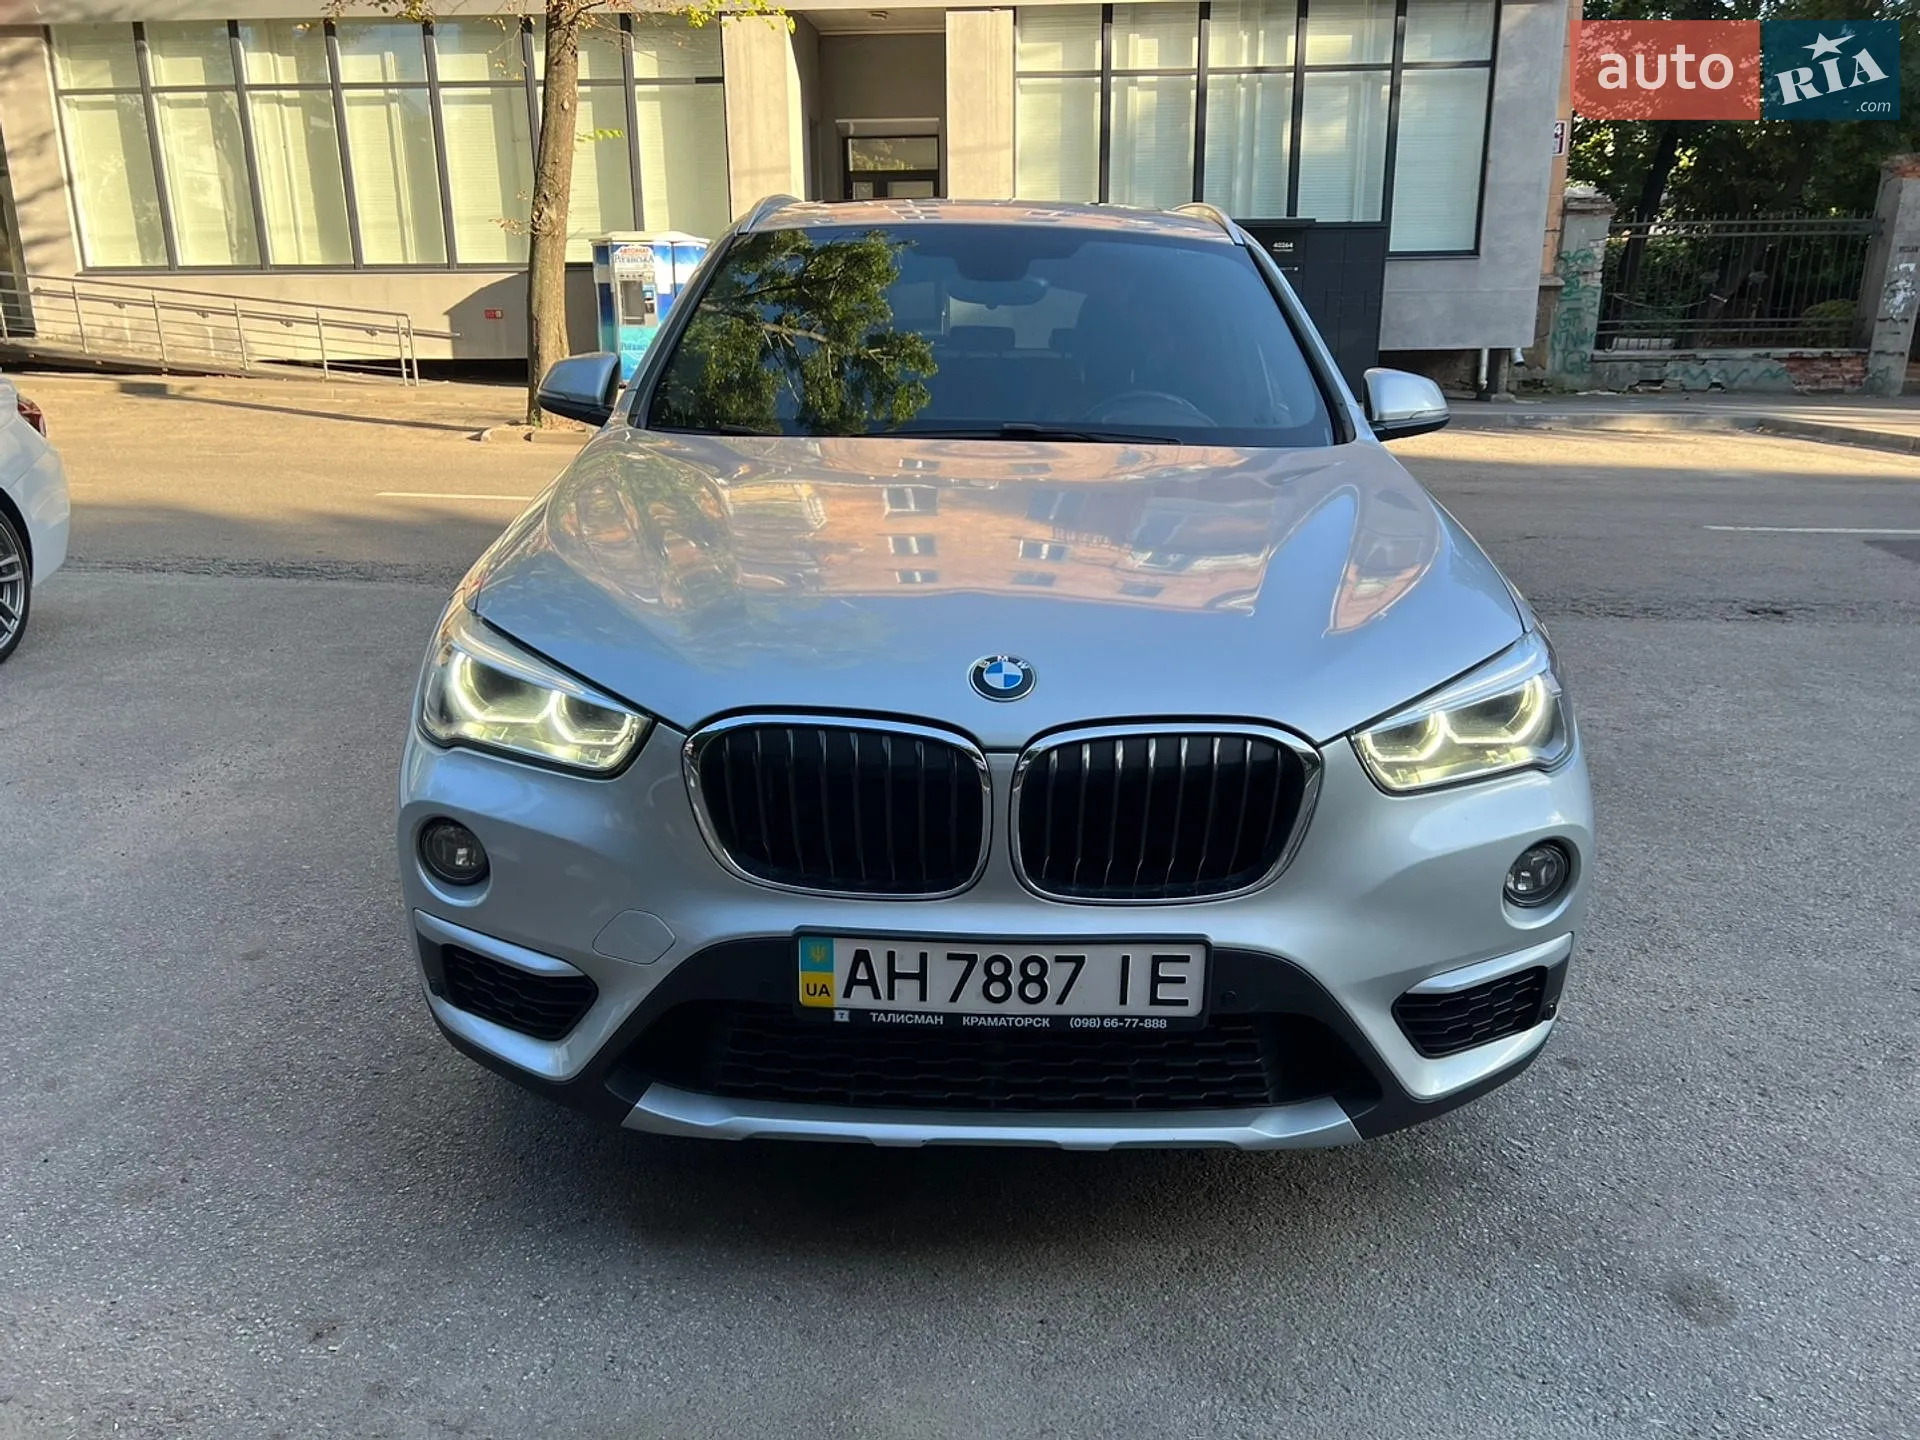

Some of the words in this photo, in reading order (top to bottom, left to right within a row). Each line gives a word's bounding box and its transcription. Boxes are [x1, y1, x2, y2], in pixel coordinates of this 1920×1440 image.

[843, 948, 928, 1002] AH
[947, 953, 1086, 1005] 7887
[1119, 954, 1191, 1006] IE
[805, 983, 831, 997] UA
[870, 1012, 944, 1025] ТАЛИСМАН
[962, 1015, 1050, 1028] КРАМАТОРСК
[1069, 1017, 1100, 1029] (098)
[1103, 1018, 1167, 1029] 66-77-888
